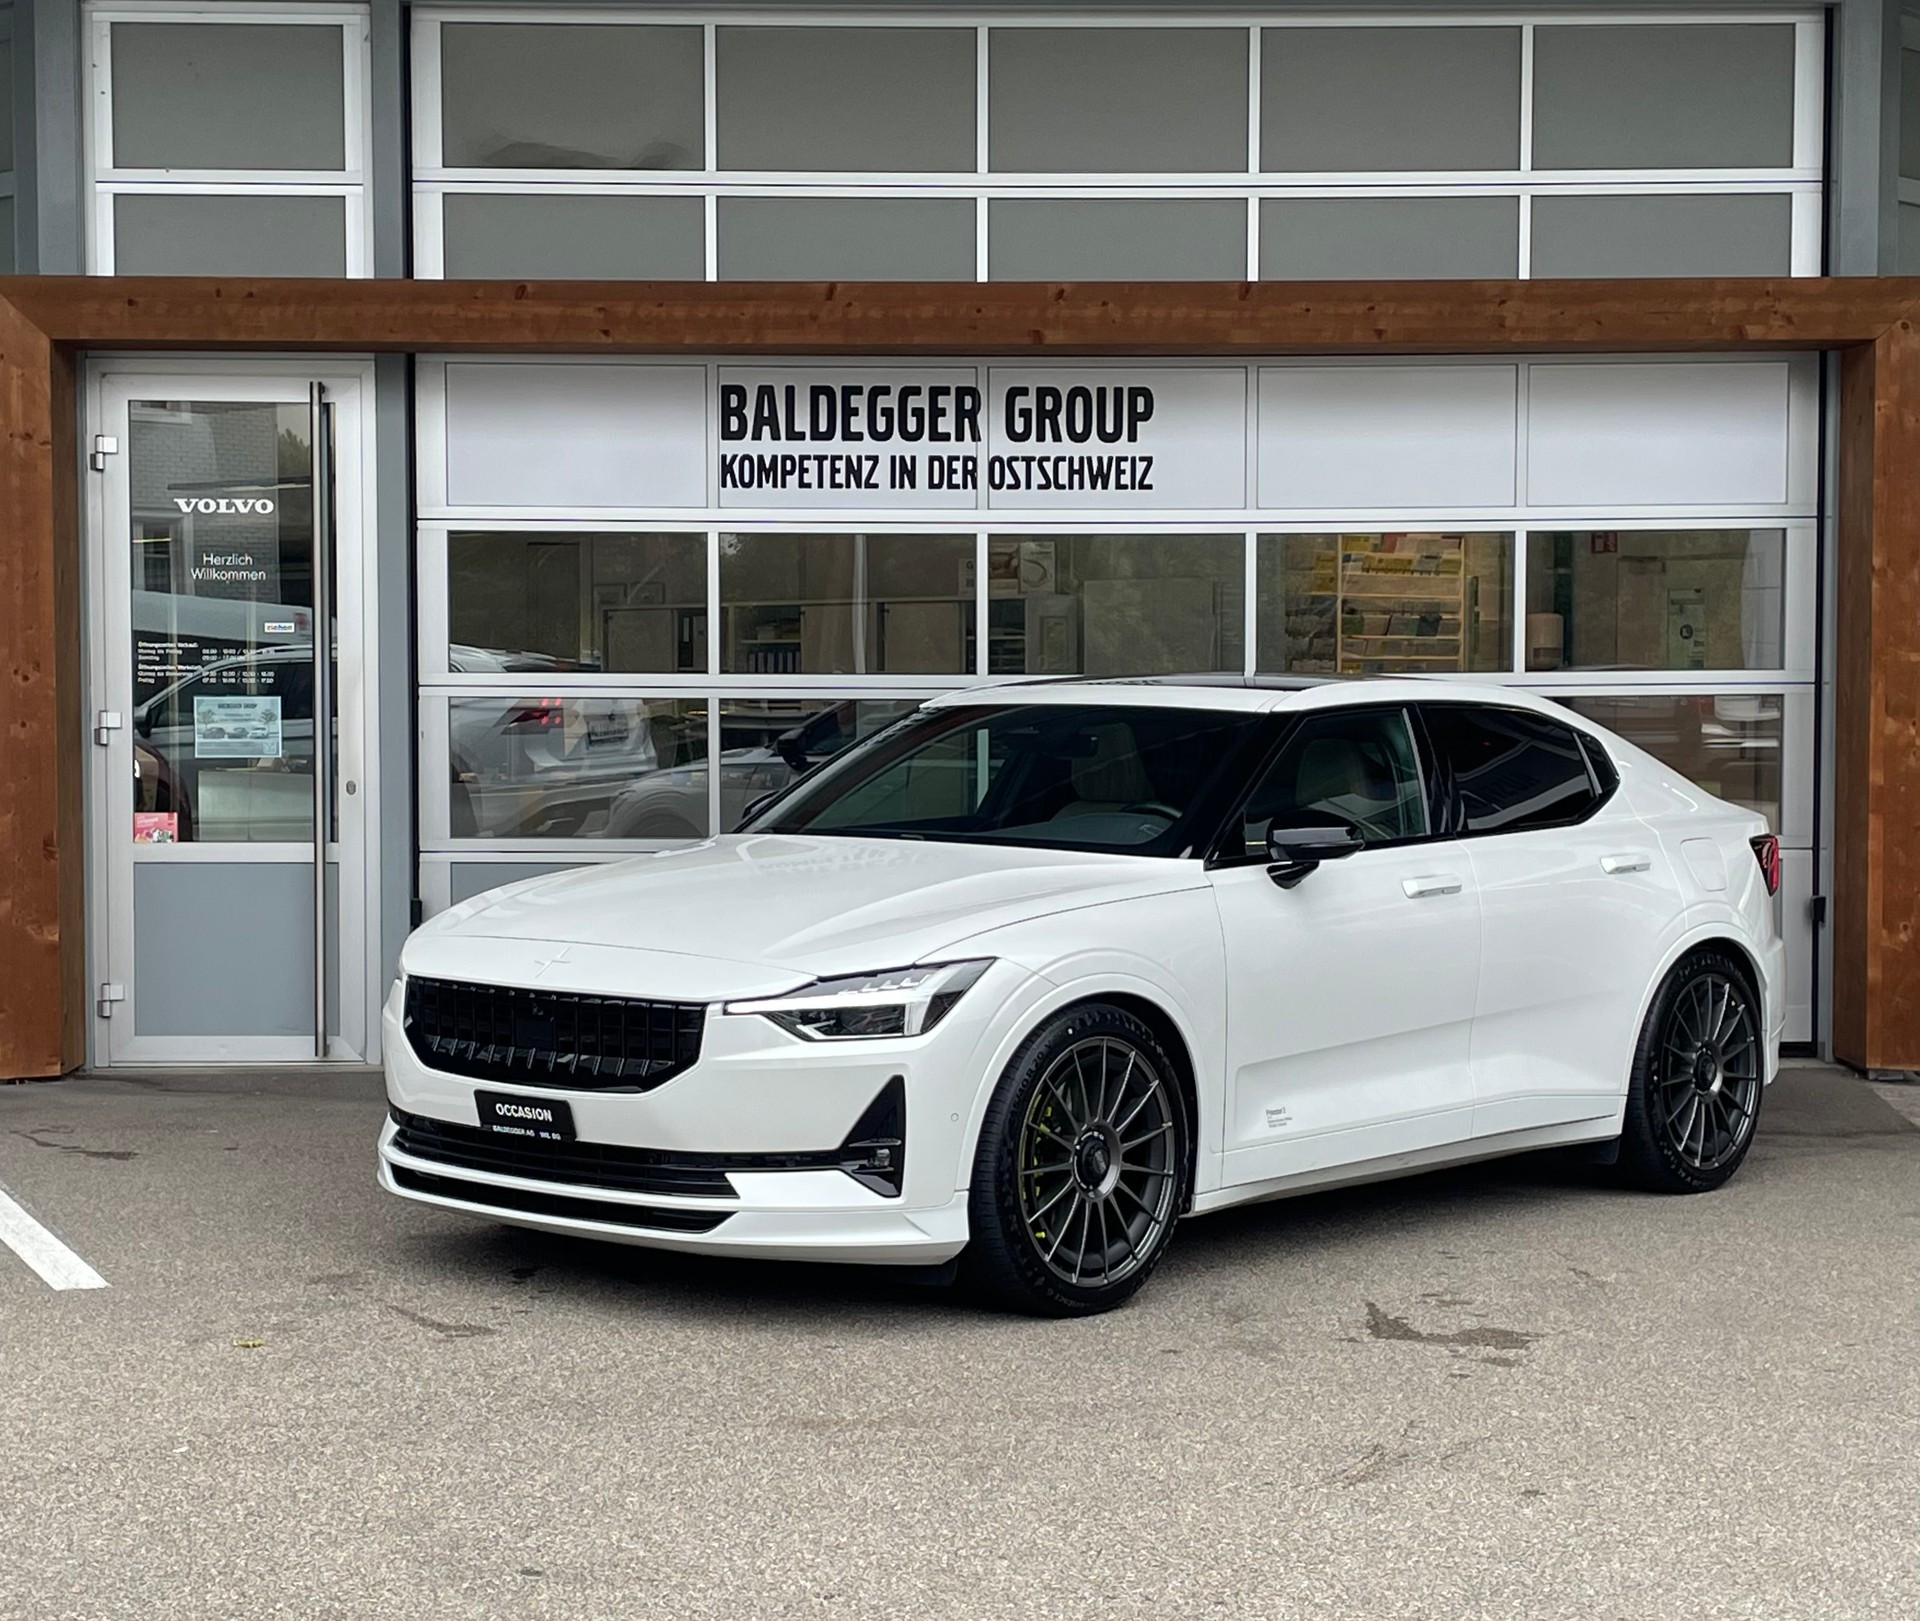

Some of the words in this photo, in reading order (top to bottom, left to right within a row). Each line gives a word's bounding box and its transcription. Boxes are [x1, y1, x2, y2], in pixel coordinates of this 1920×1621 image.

[720, 384, 981, 442] BALDEGGER
[1005, 386, 1154, 444] GROUP
[720, 454, 880, 489] KOMPETENZ
[890, 454, 916, 490] IN
[928, 455, 977, 490] DER
[988, 456, 1154, 491] OSTSCHWEIZ
[173, 498, 274, 514] VOLVO
[203, 552, 253, 566] Herzlich
[190, 567, 266, 580] Willkommen
[495, 1103, 553, 1122] OCCASION
